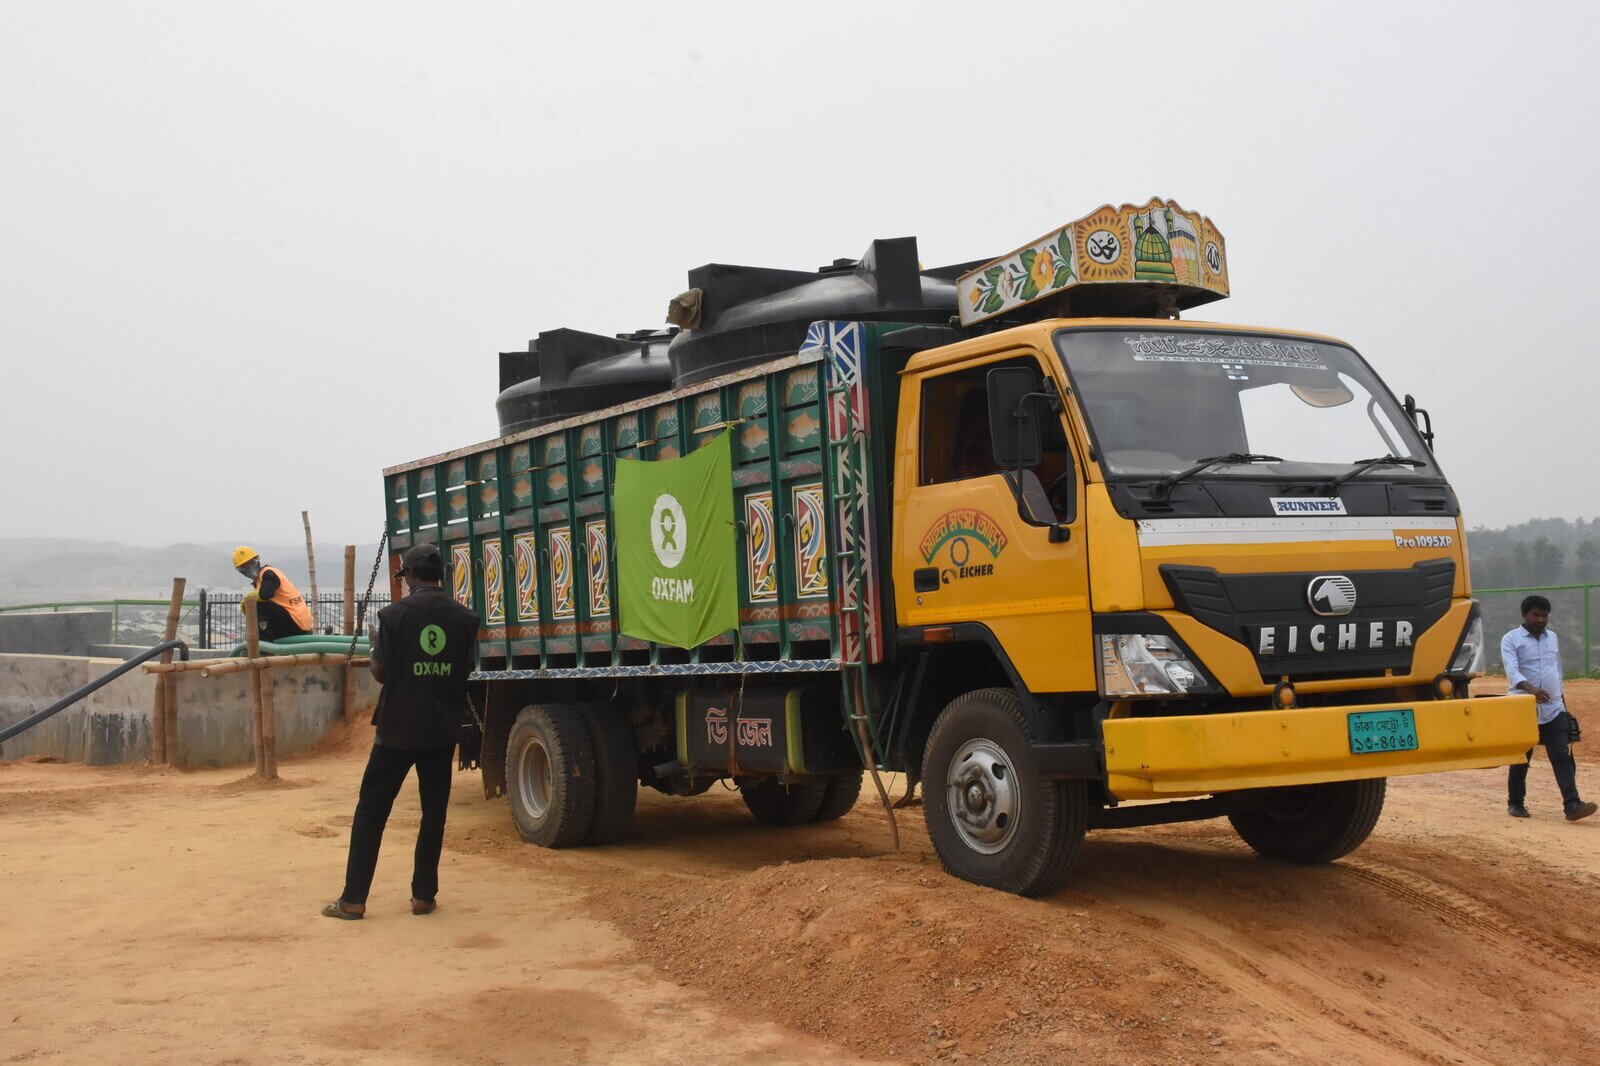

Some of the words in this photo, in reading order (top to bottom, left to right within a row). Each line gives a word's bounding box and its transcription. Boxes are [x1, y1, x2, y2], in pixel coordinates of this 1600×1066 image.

[1276, 500, 1341, 512] RUNNER
[959, 563, 994, 579] EICHER
[652, 576, 694, 603] OXFAM
[1259, 621, 1413, 654] EICHER
[413, 661, 452, 676] OXAM
[1354, 721, 1373, 732] ঢাকা
[1354, 734, 1414, 751] ১৩-৪৫৬৫
